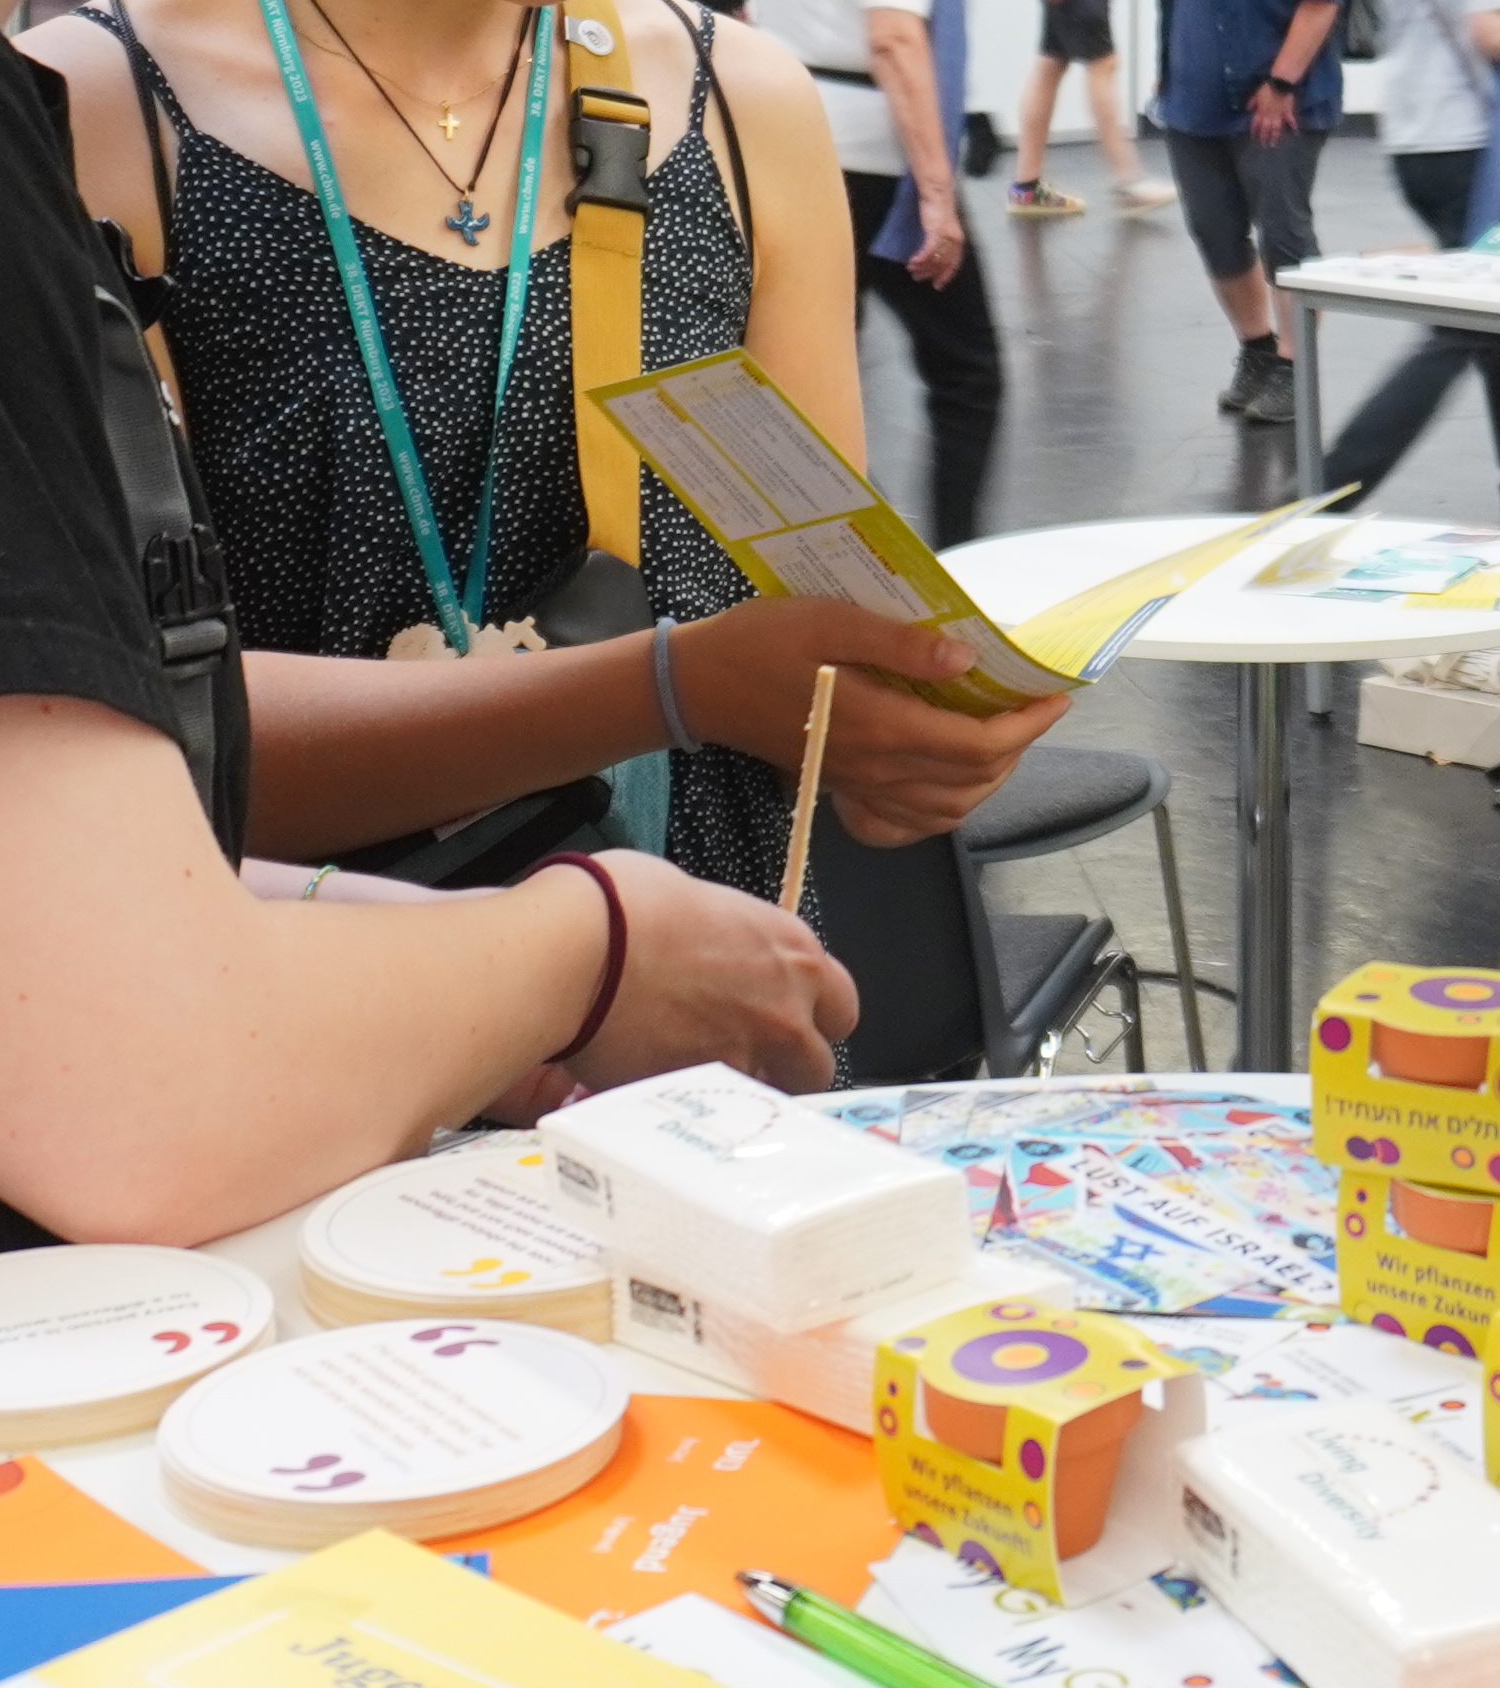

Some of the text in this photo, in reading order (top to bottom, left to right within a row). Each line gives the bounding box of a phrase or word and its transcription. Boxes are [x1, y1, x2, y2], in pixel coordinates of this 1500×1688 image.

[271, 17, 297, 76] Nürnberg
[288, 72, 308, 103] 2023
[310, 140, 341, 220] www.cbm.de
[517, 156, 536, 235] www.cbm.de
[350, 283, 369, 317] DEKT
[359, 317, 386, 382] Nürnberg
[397, 451, 431, 537] www.cbm.de
[1407, 1109, 1441, 1131] את
[1069, 1159, 1335, 1294] LUST AUF ISRAEL?
[1366, 1278, 1491, 1327] unsere Zukun
[1377, 1252, 1496, 1302] Wir pflanzen
[1304, 1427, 1369, 1474] Living
[903, 1482, 958, 1520] unsere
[910, 1452, 1015, 1520] Wir pflanzen
[1297, 1471, 1386, 1540] Diversity
